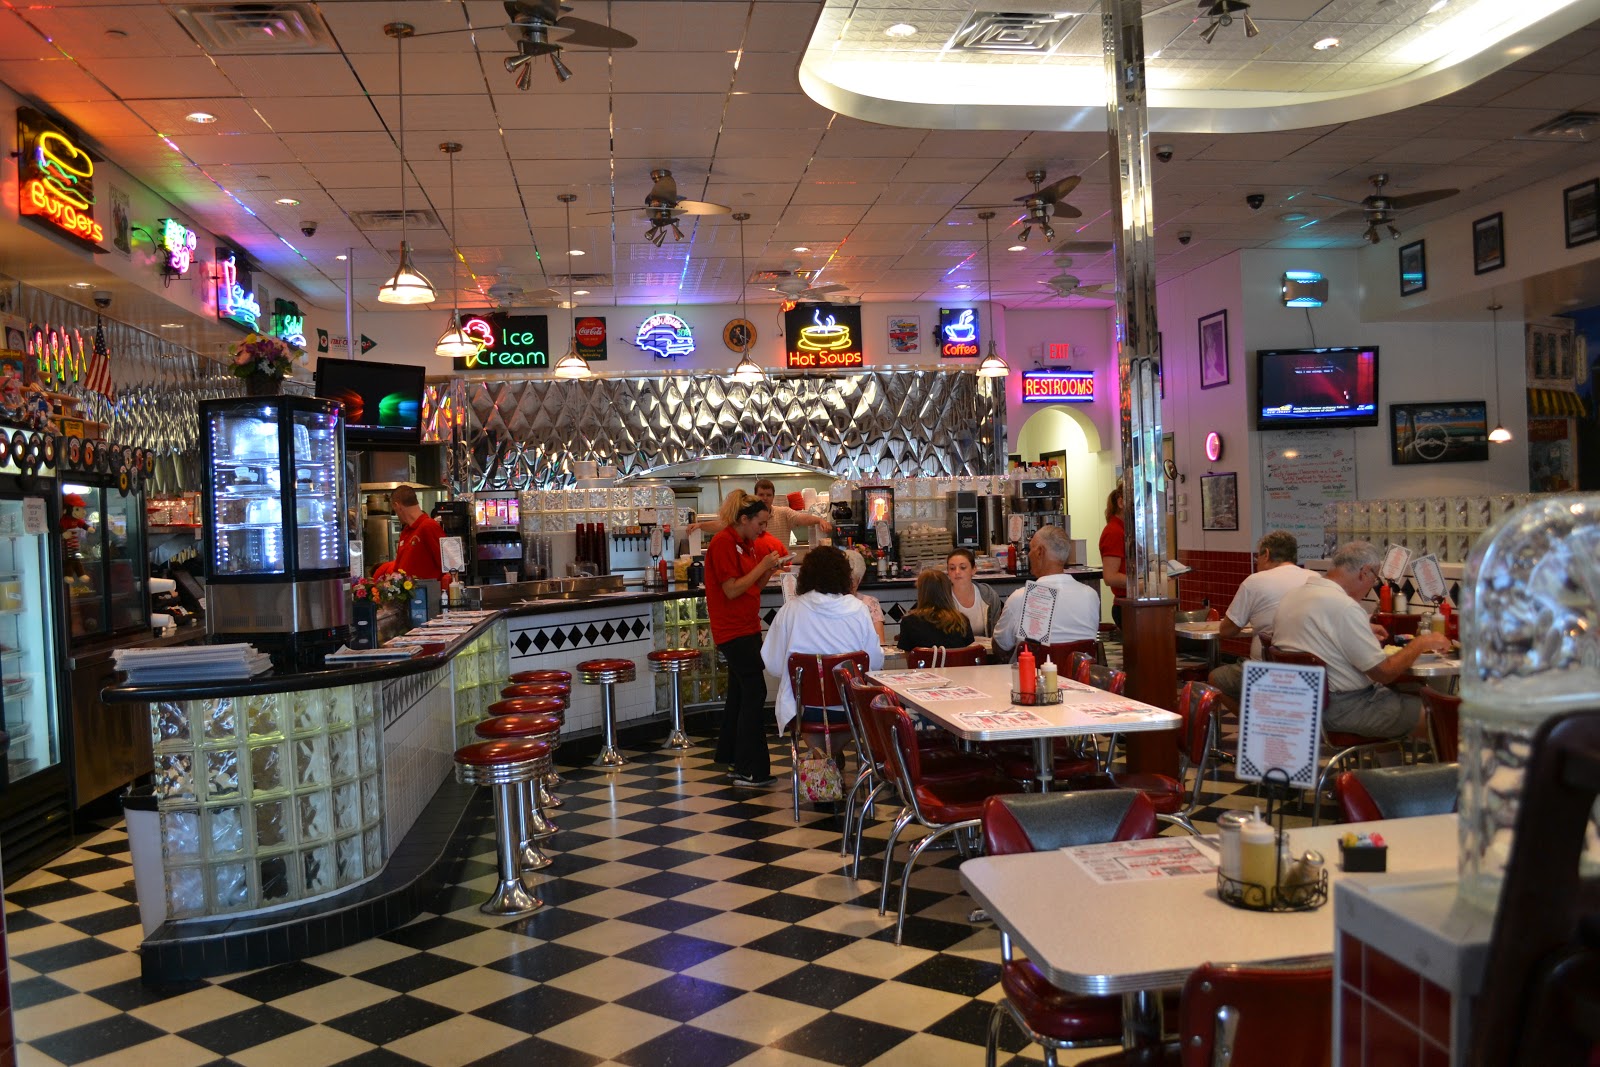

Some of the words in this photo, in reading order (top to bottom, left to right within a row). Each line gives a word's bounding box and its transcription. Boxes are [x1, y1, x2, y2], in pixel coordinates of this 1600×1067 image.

[32, 181, 103, 241] Burgers
[503, 328, 534, 345] Ice
[578, 326, 602, 336] Coca-Cola
[476, 349, 546, 365] Cream
[943, 343, 977, 355] Coffee
[1049, 344, 1069, 359] EXIT
[789, 352, 815, 366] Hot
[819, 350, 861, 366] Soups
[1025, 378, 1094, 396] RESTROOMS
